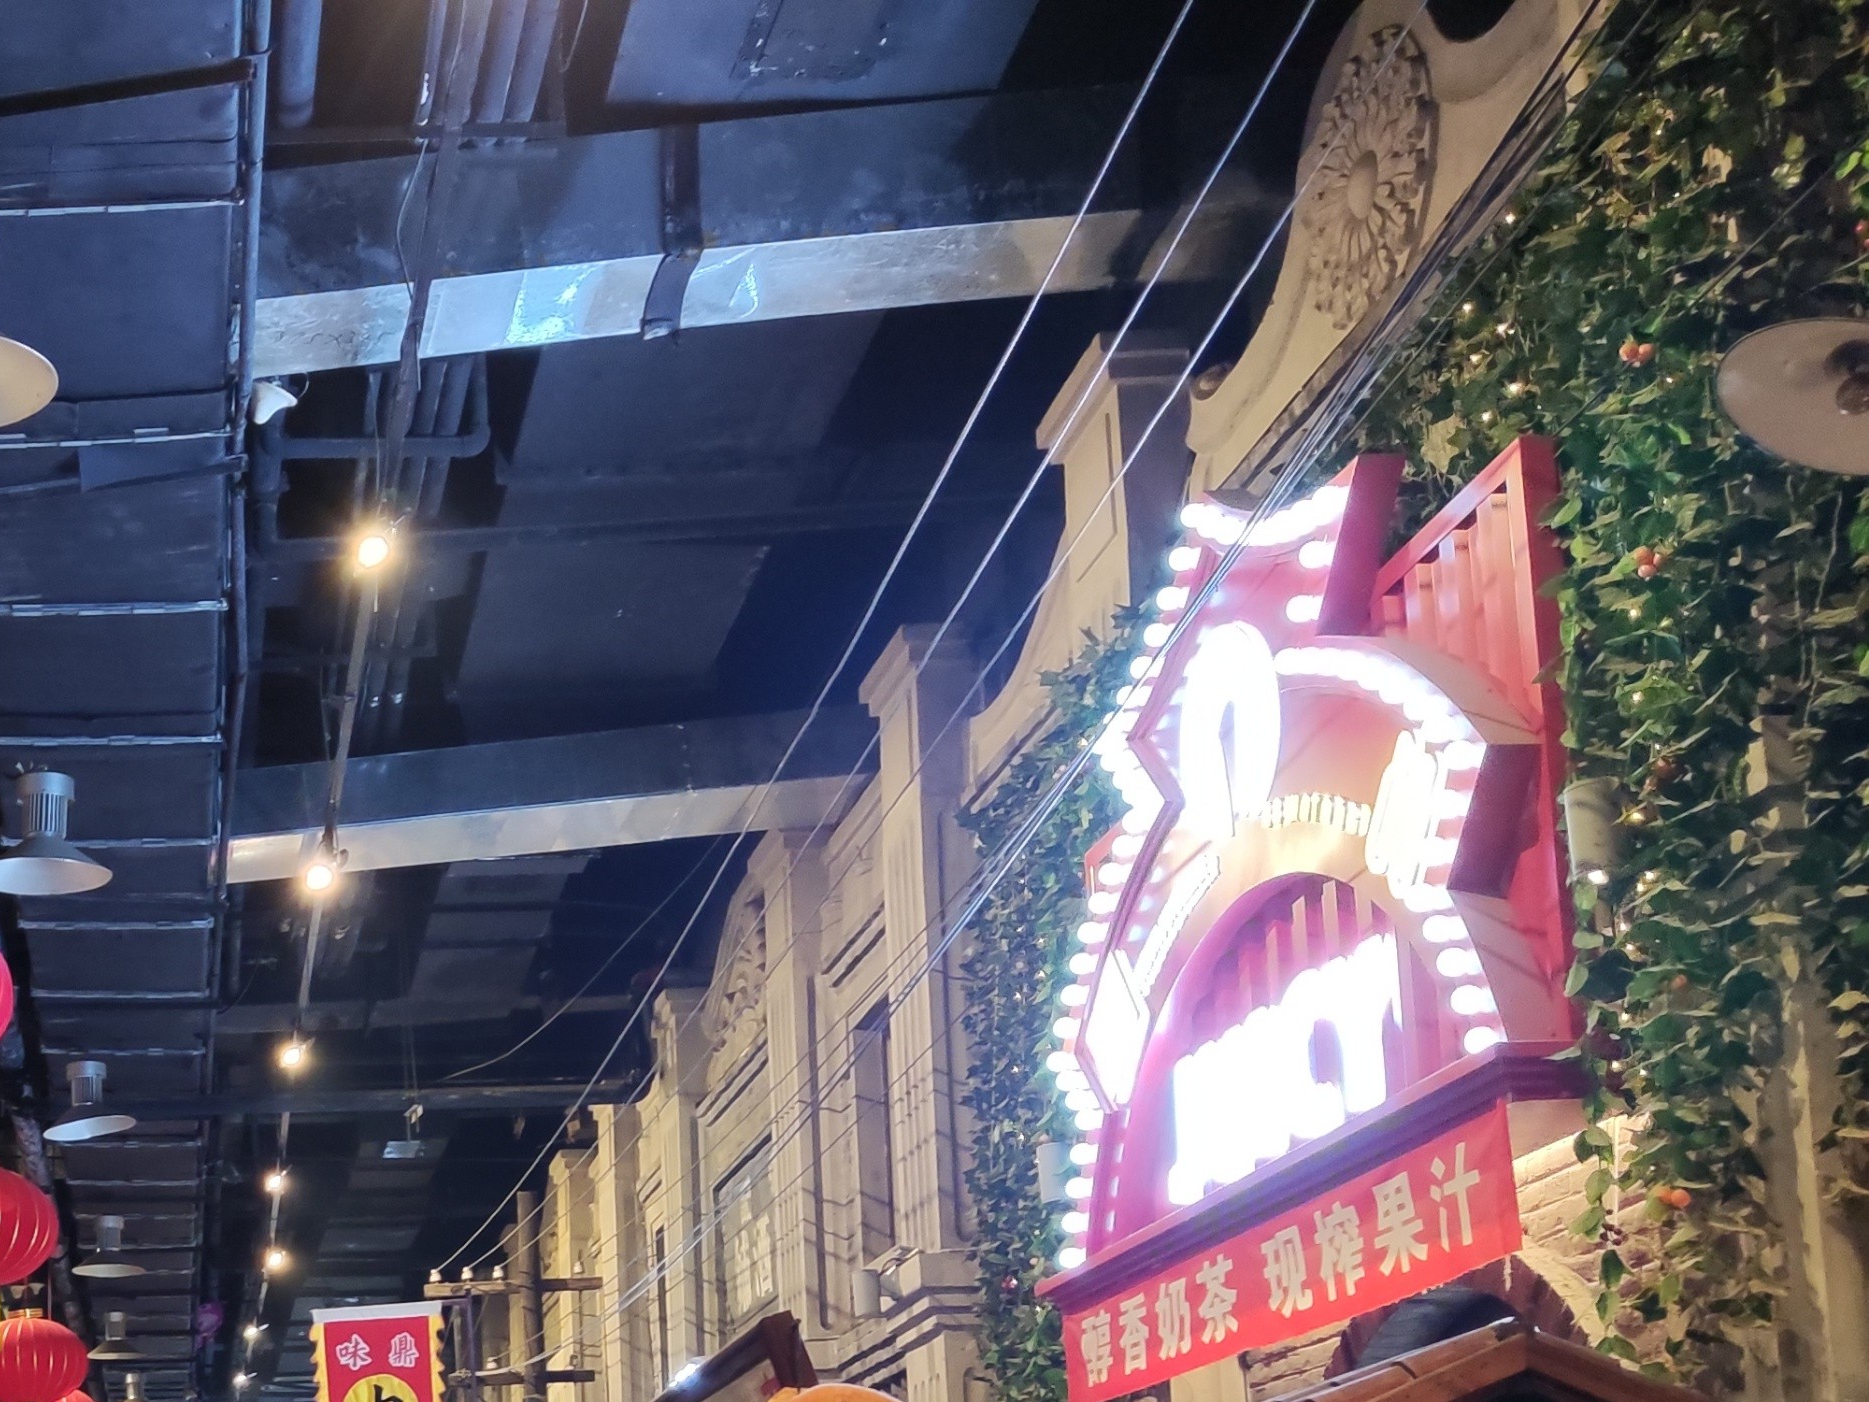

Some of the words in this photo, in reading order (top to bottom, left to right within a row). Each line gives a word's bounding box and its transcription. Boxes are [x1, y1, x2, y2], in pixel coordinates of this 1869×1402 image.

[1081, 1253, 1239, 1388] 醇香奶茶
[1261, 1142, 1481, 1318] 现榨果汁
